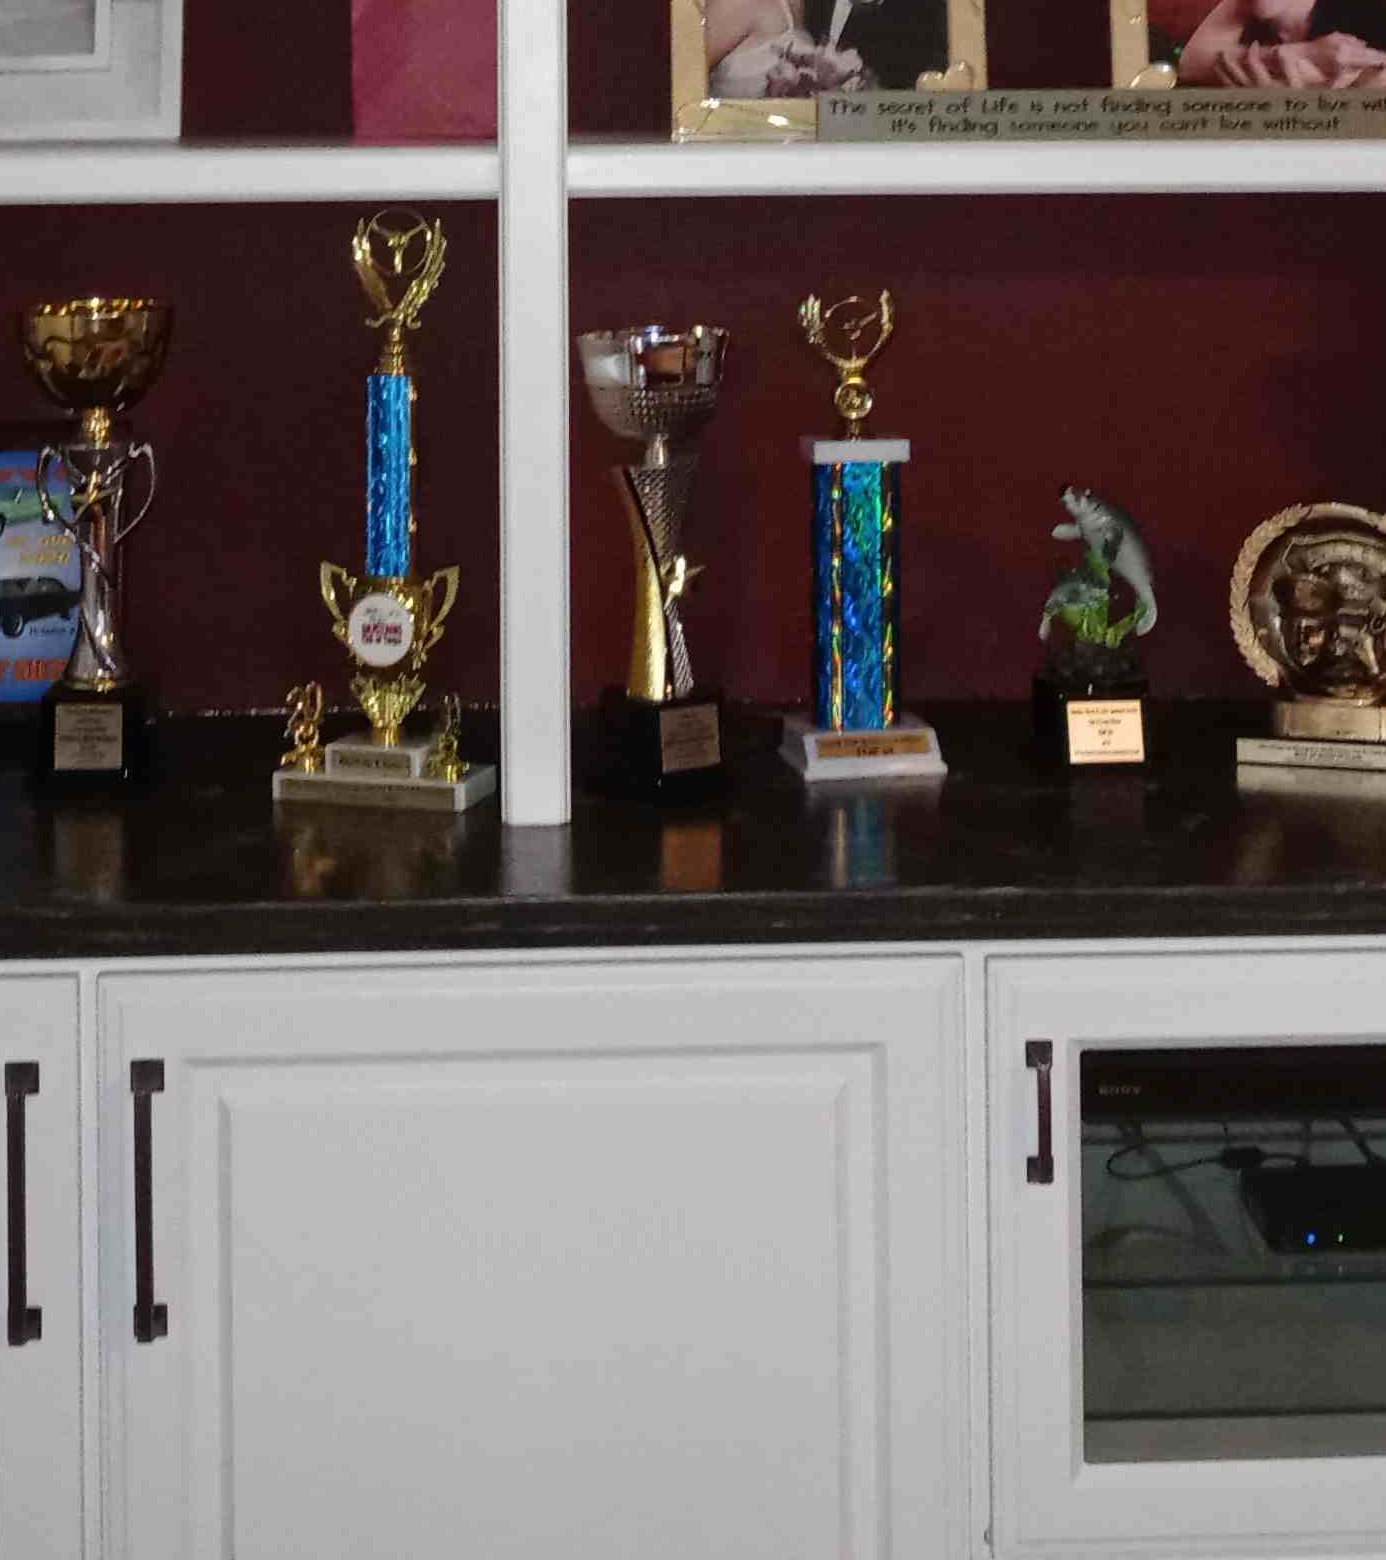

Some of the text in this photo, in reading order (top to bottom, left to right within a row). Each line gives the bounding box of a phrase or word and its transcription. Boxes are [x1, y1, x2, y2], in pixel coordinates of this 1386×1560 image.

[828, 97, 867, 116] The
[876, 98, 935, 116] secret
[945, 96, 971, 115] of
[1029, 98, 1045, 114] is
[1053, 96, 1090, 114] not
[1100, 94, 1173, 116] finding
[1181, 98, 1273, 113] someone
[1284, 96, 1310, 113] to
[1318, 94, 1350, 113] live
[928, 115, 999, 136] finding
[1010, 118, 1100, 133] someone
[1109, 118, 1149, 135] you
[1219, 114, 1254, 131] live
[1263, 115, 1342, 132] without
